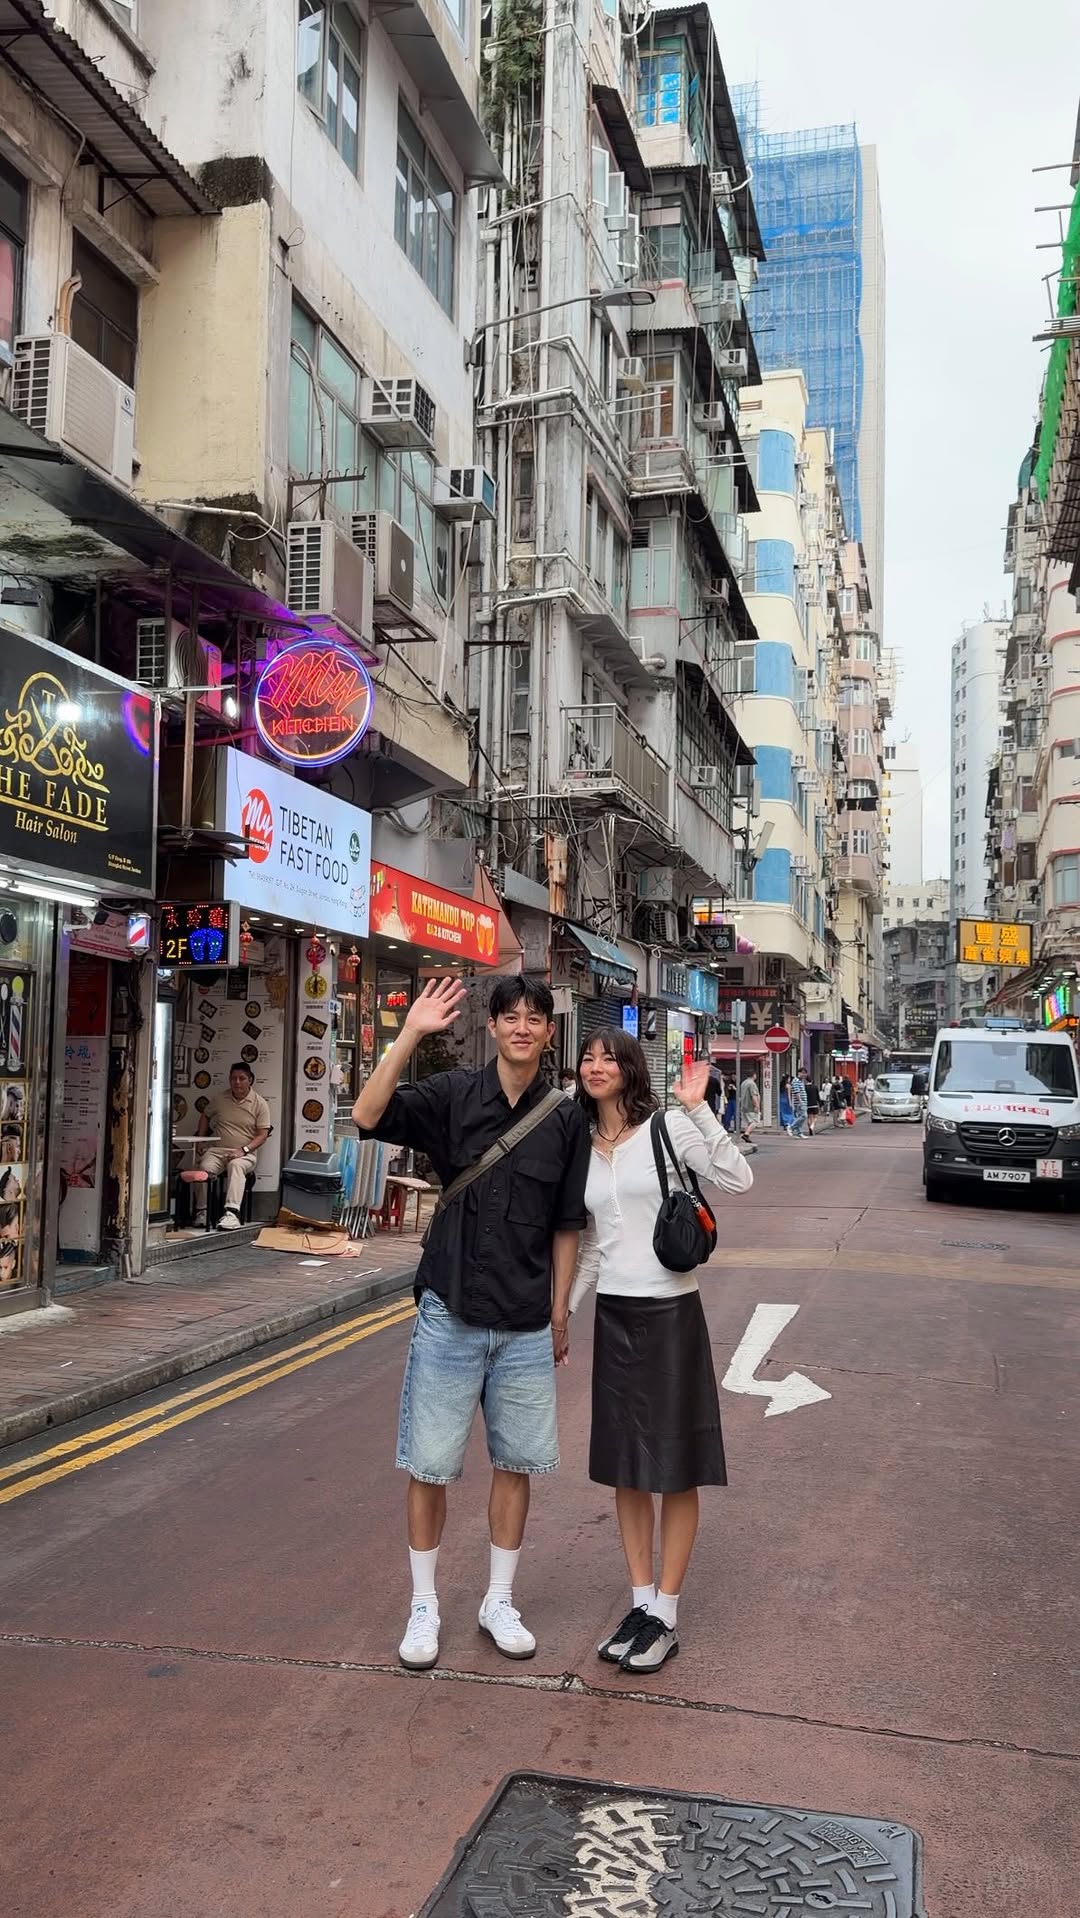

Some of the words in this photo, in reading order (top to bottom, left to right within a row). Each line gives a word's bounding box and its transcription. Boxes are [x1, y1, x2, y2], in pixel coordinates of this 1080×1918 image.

[271, 715, 354, 736] KITCHEN
[0, 764, 31, 800] HE
[45, 780, 107, 824] FADE
[15, 810, 43, 834] Hair
[45, 819, 77, 844] Salon
[245, 796, 273, 840] My
[280, 806, 333, 850] TIBETAN
[281, 841, 312, 874] FAST
[315, 853, 349, 885] FOOD
[412, 890, 460, 928] KATHMANDU
[461, 909, 475, 933] TOP
[166, 938, 187, 958] 2F
[975, 923, 1018, 946] 豐盛
[986, 1172, 999, 1180] AM
[1002, 1172, 1026, 1180] 7907
